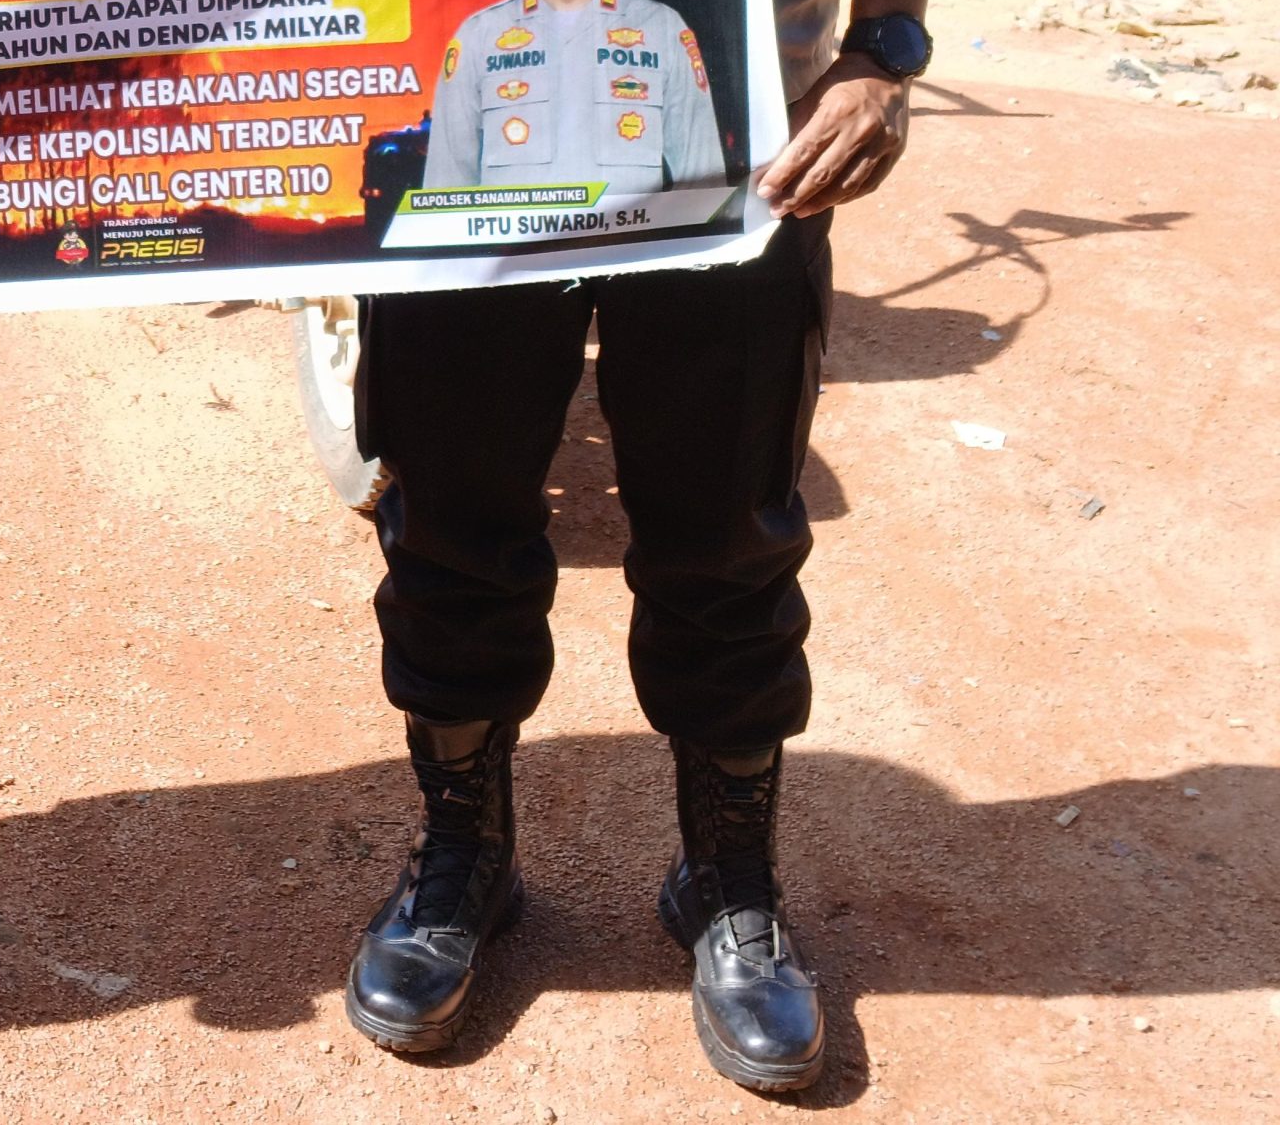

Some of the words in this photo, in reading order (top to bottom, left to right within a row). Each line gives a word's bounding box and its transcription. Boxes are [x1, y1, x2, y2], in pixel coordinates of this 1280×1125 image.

[75, 27, 131, 53] DAN
[137, 22, 228, 48] DENDA
[233, 20, 257, 41] 15
[264, 14, 361, 40] MILYAR
[486, 49, 546, 72] SUWARDI
[596, 48, 659, 69] POLRI
[121, 72, 300, 108] KEBAKARAN
[304, 66, 420, 97] SEGERA
[39, 123, 212, 160] KEPOLISIAN
[216, 115, 364, 149] TERDEKAT
[91, 173, 167, 204] CALL
[170, 169, 283, 200] CENTER
[287, 166, 330, 194] 110
[412, 193, 472, 207] KAPOLSEK
[473, 191, 530, 205] SANAMAN
[531, 189, 586, 203] MANTIKEI
[102, 216, 178, 228] TRANSFORMASI
[102, 230, 144, 240] MENUJU
[145, 229, 175, 238] POLRI
[176, 226, 204, 236] YANG
[467, 216, 511, 236] IPTU
[517, 212, 610, 234] SUWARDI,
[615, 208, 651, 226] S.H.
[100, 237, 206, 260] PRESISI
